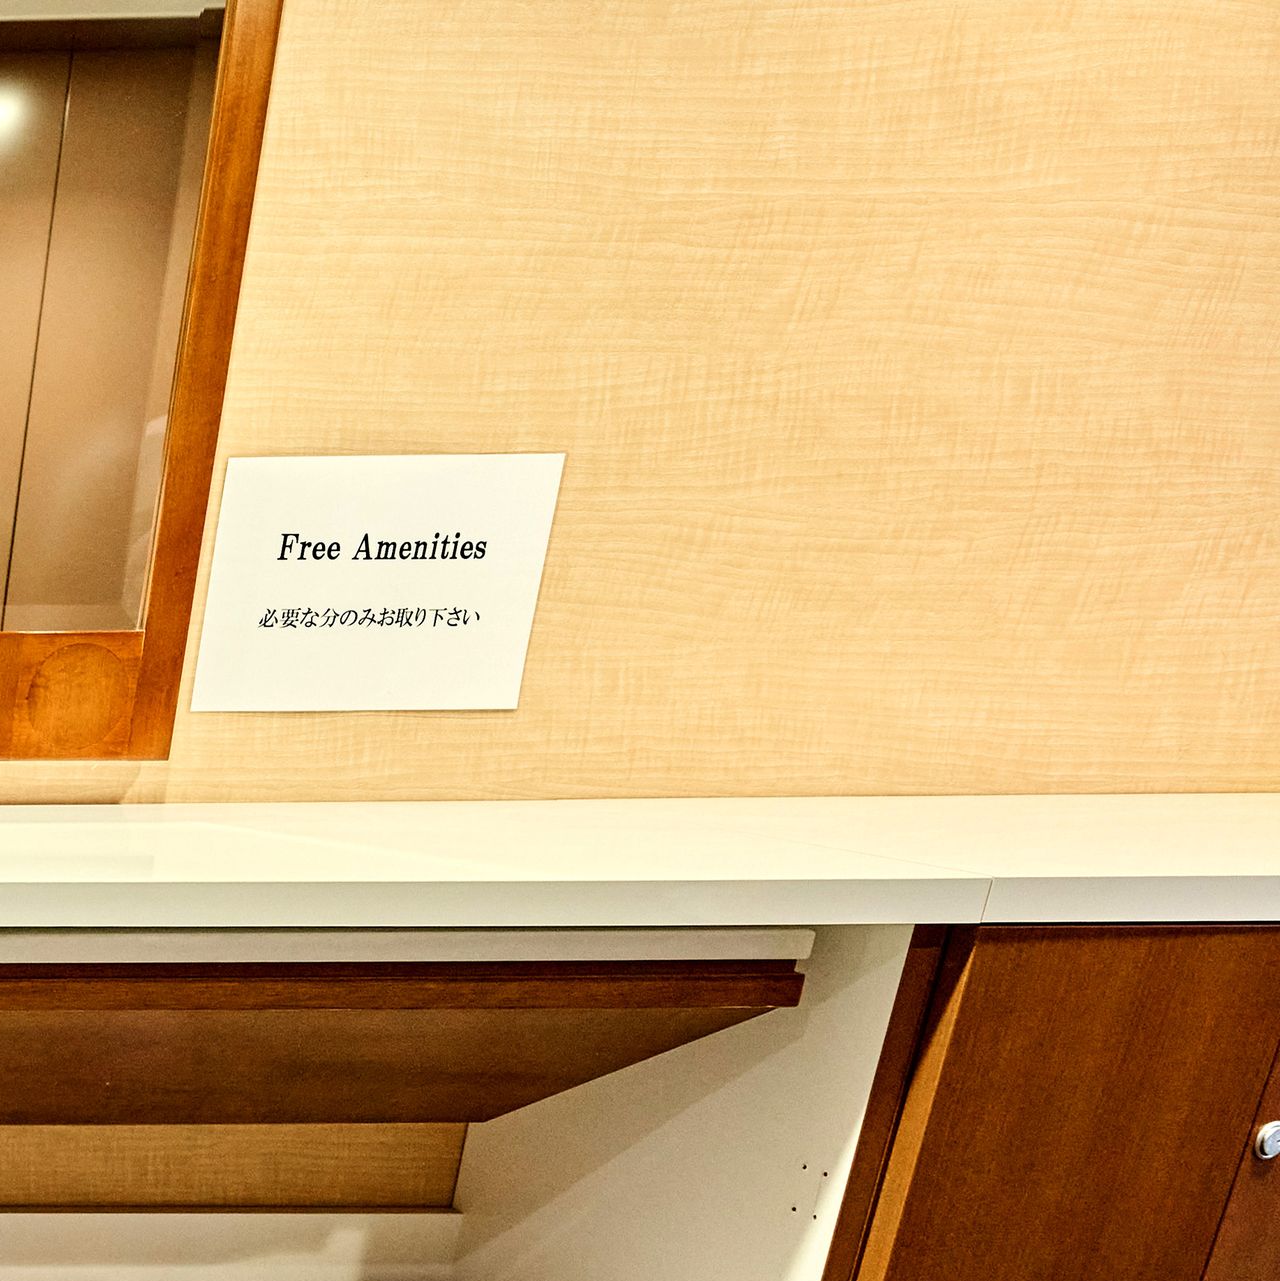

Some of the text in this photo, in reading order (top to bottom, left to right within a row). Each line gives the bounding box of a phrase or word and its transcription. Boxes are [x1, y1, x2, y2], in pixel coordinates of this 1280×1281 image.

[277, 532, 487, 561] Free Amenities
[258, 607, 480, 629] 必要な分のみお取り下さい
